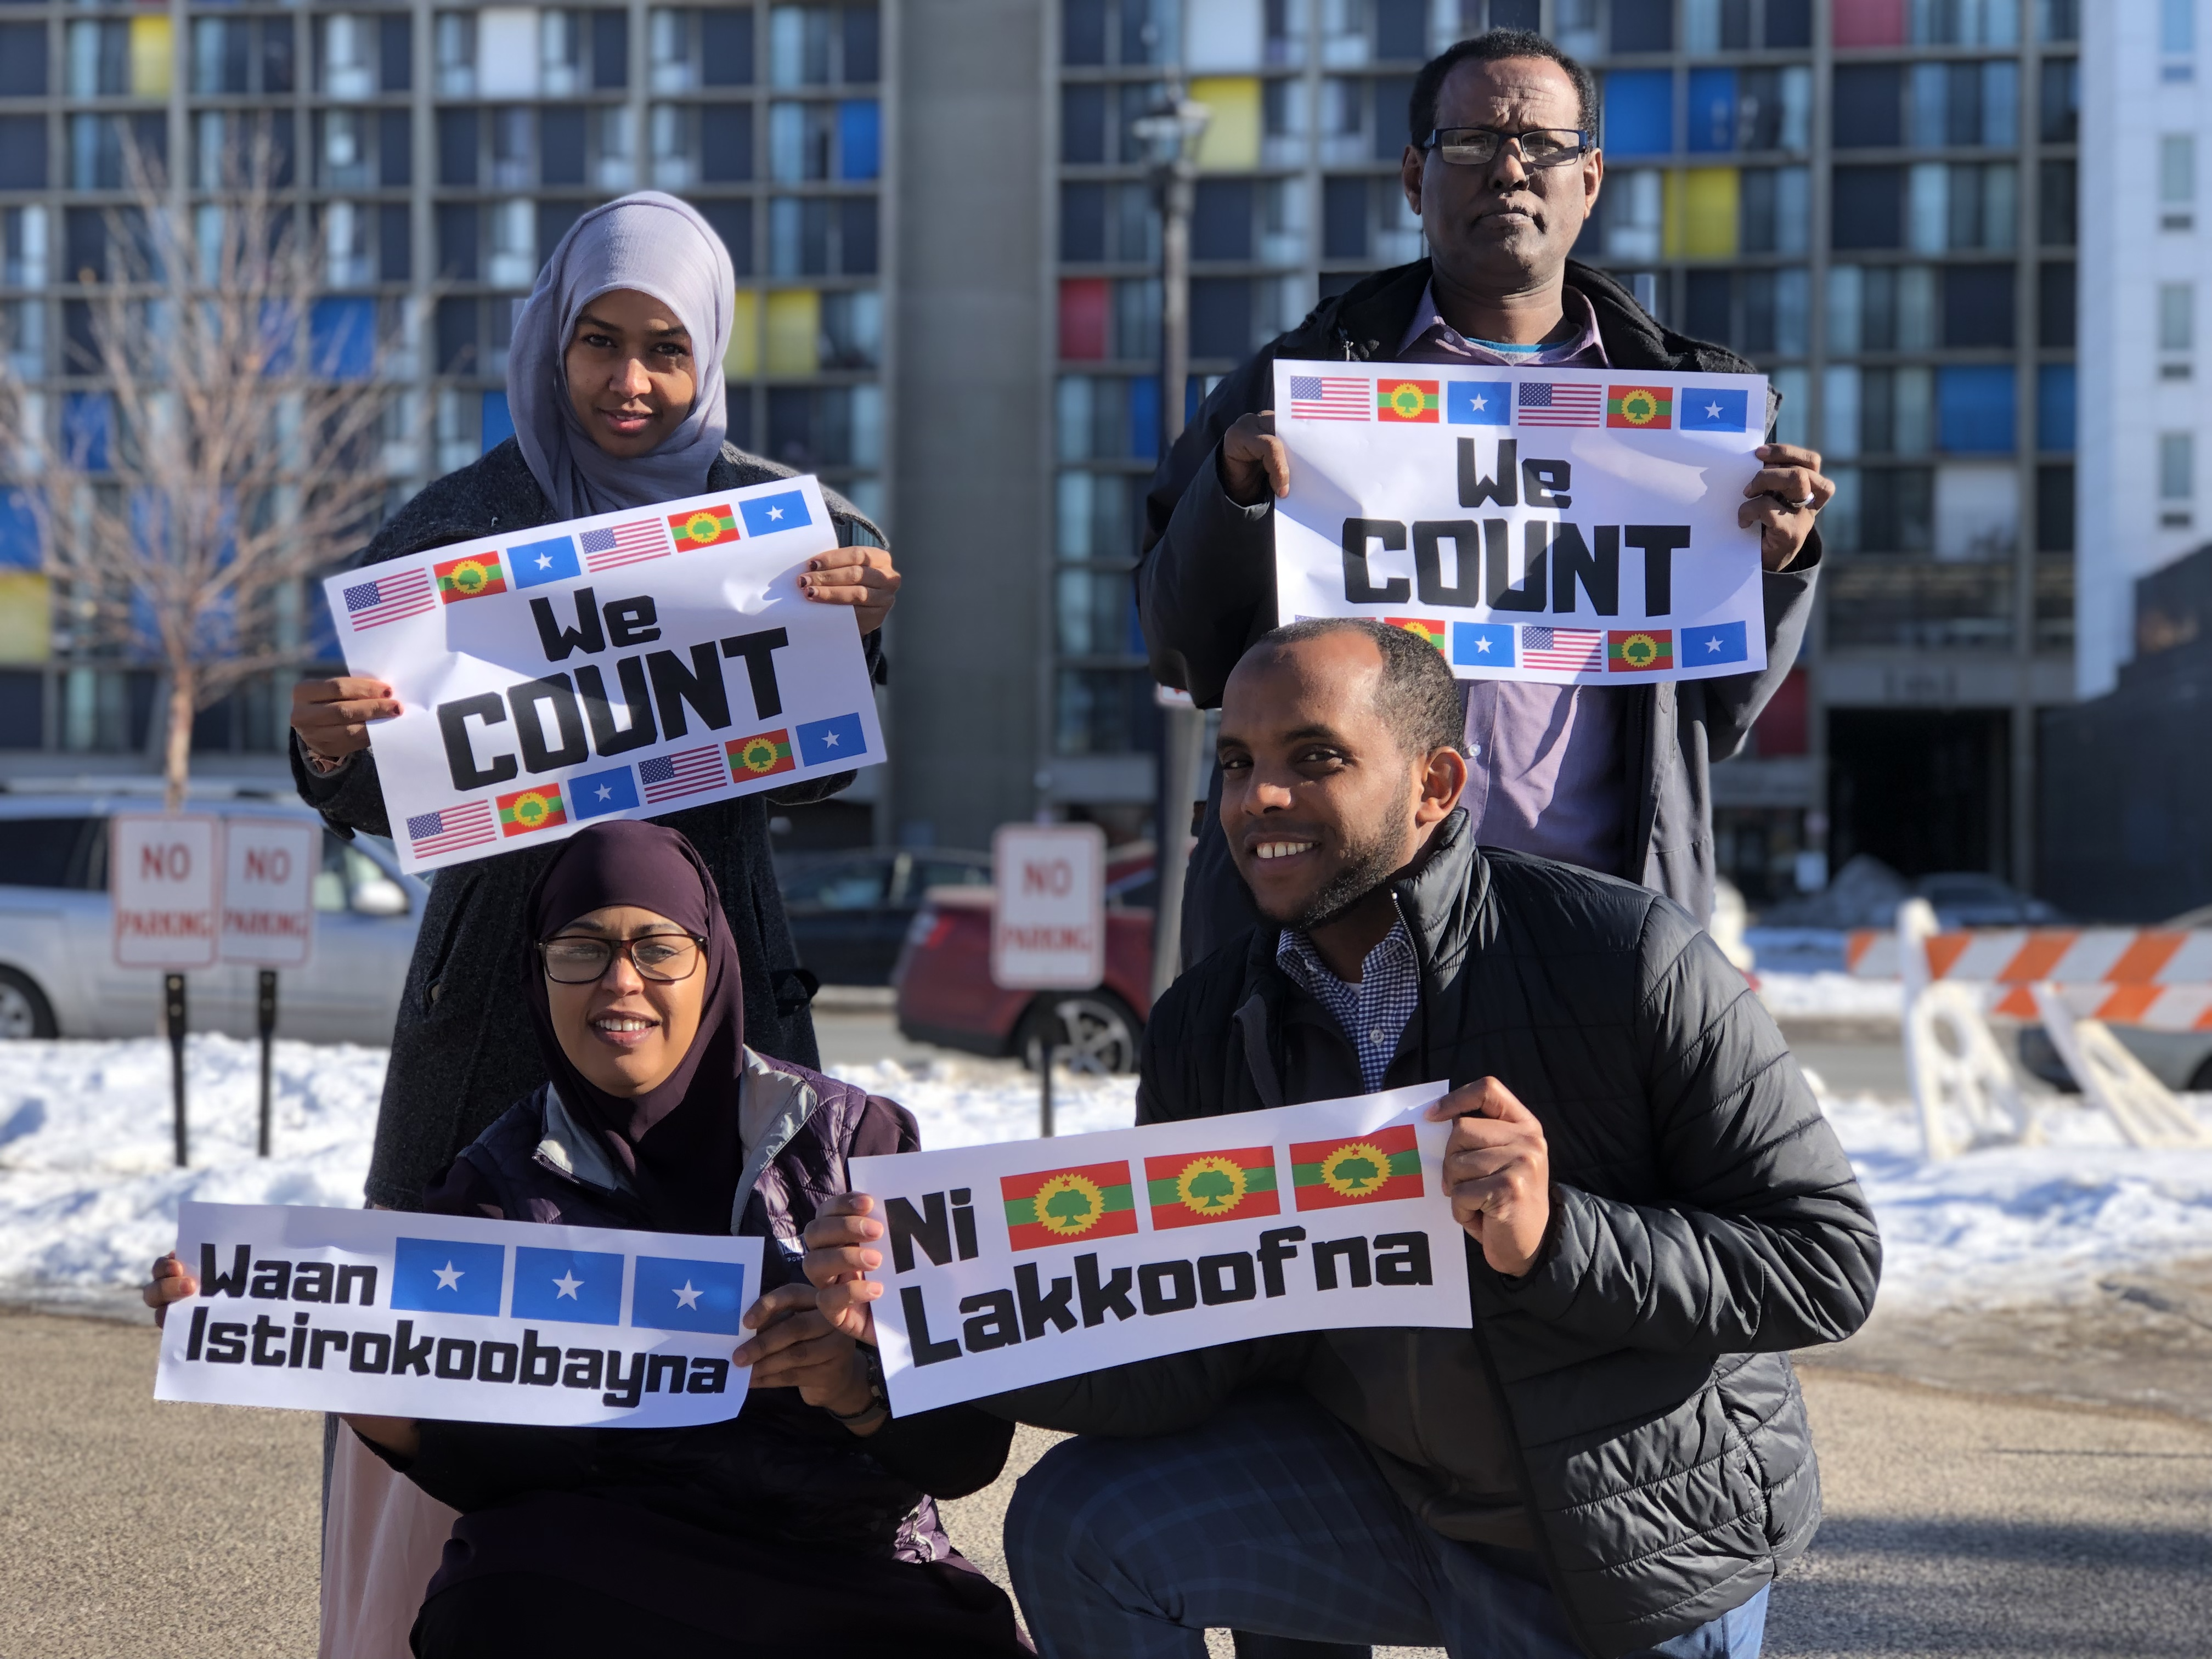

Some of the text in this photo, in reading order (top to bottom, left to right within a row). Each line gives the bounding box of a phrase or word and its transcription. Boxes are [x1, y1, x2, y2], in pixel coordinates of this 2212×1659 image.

[1457, 437, 1572, 509] We
[1341, 517, 1691, 617] COUNT
[529, 587, 662, 662] We
[437, 627, 789, 792] COUNT
[142, 843, 191, 882] NO
[245, 848, 291, 884] NO
[1022, 859, 1071, 898] NO
[117, 911, 213, 936] PARKING
[223, 911, 308, 936] PARKING
[884, 1187, 979, 1274] Ni
[200, 1243, 377, 1306] Waan
[900, 1225, 1434, 1368] Lakkoofna
[185, 1306, 730, 1408] Istirokoobayna
